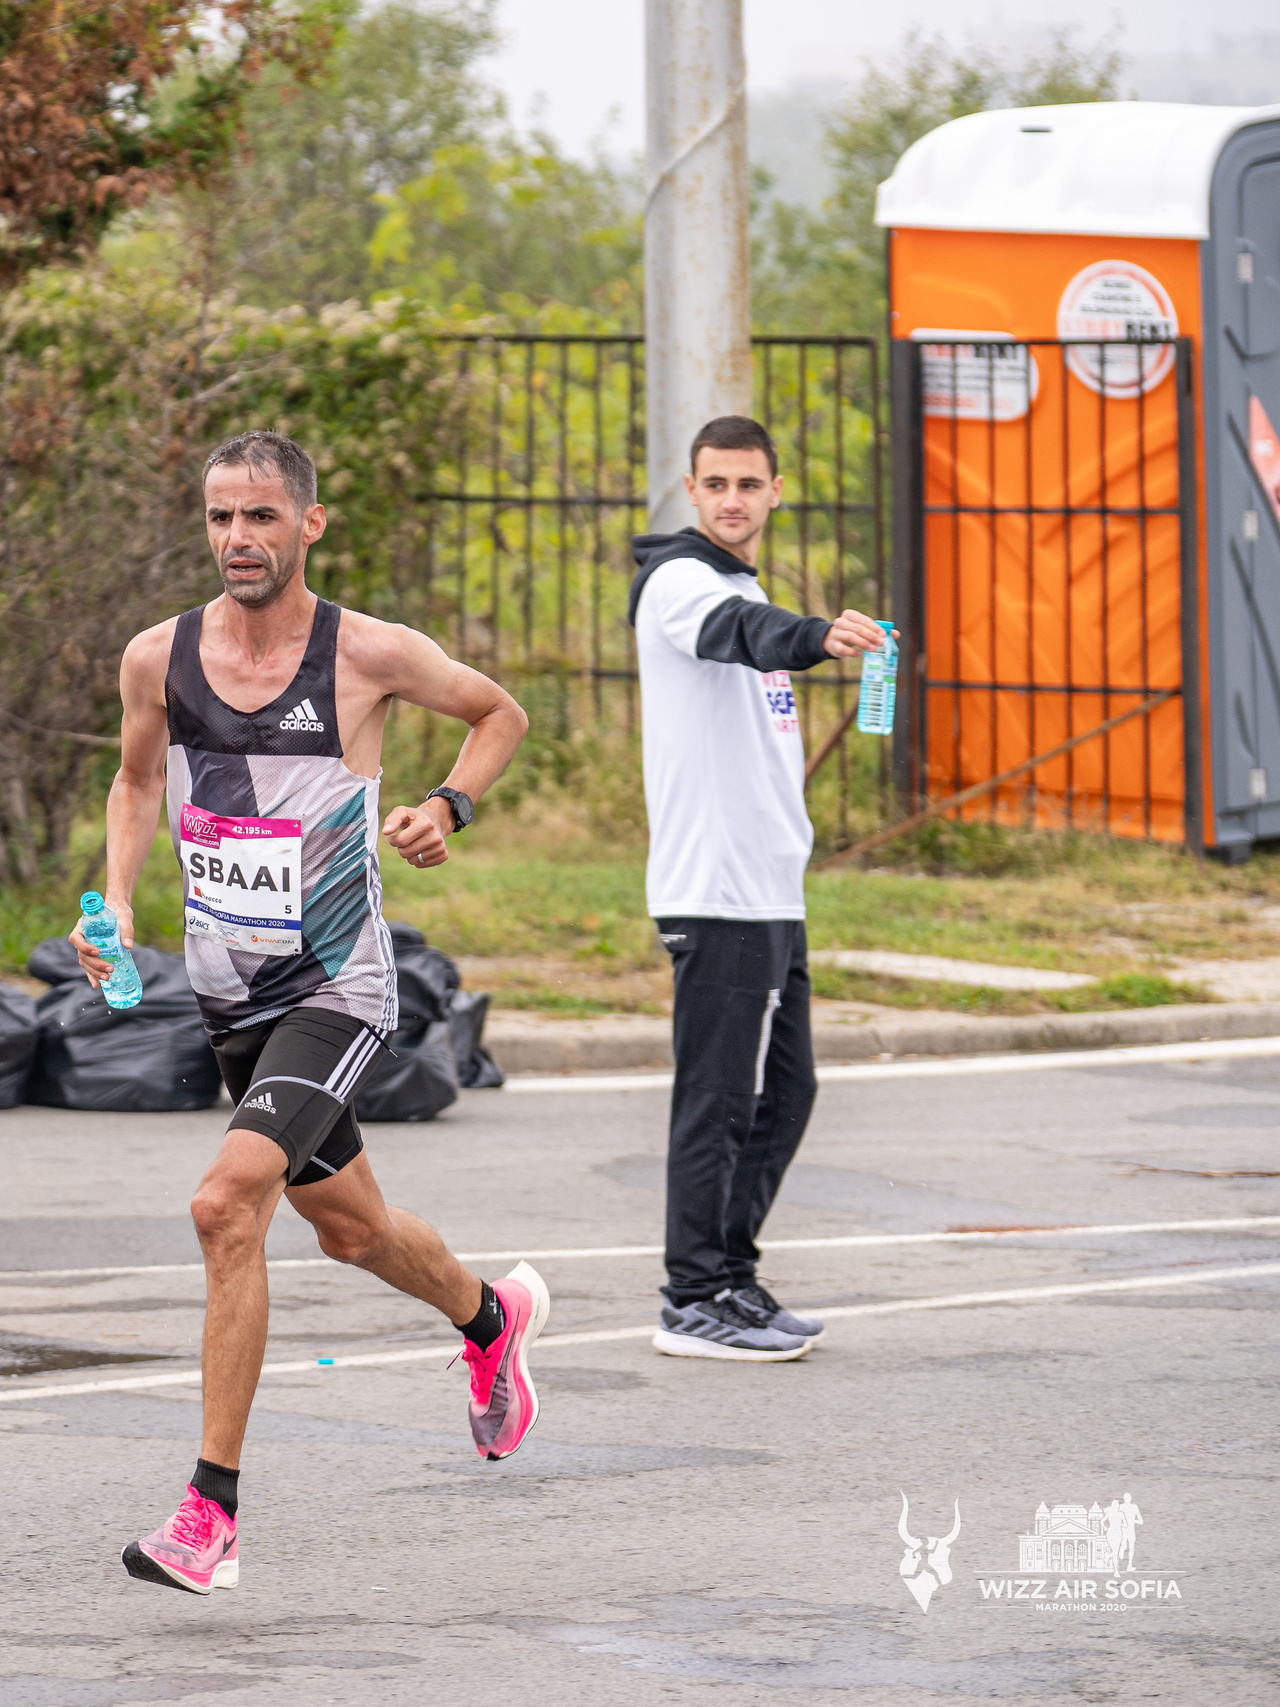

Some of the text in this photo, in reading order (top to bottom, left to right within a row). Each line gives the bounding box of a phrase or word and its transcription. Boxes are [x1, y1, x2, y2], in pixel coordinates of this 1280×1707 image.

[279, 718, 324, 732] adidas
[232, 825, 260, 834] 42.195
[189, 852, 290, 892] SBAAI
[284, 905, 292, 914] 5
[230, 914, 267, 926] MARATHON
[244, 1101, 277, 1115] adidas
